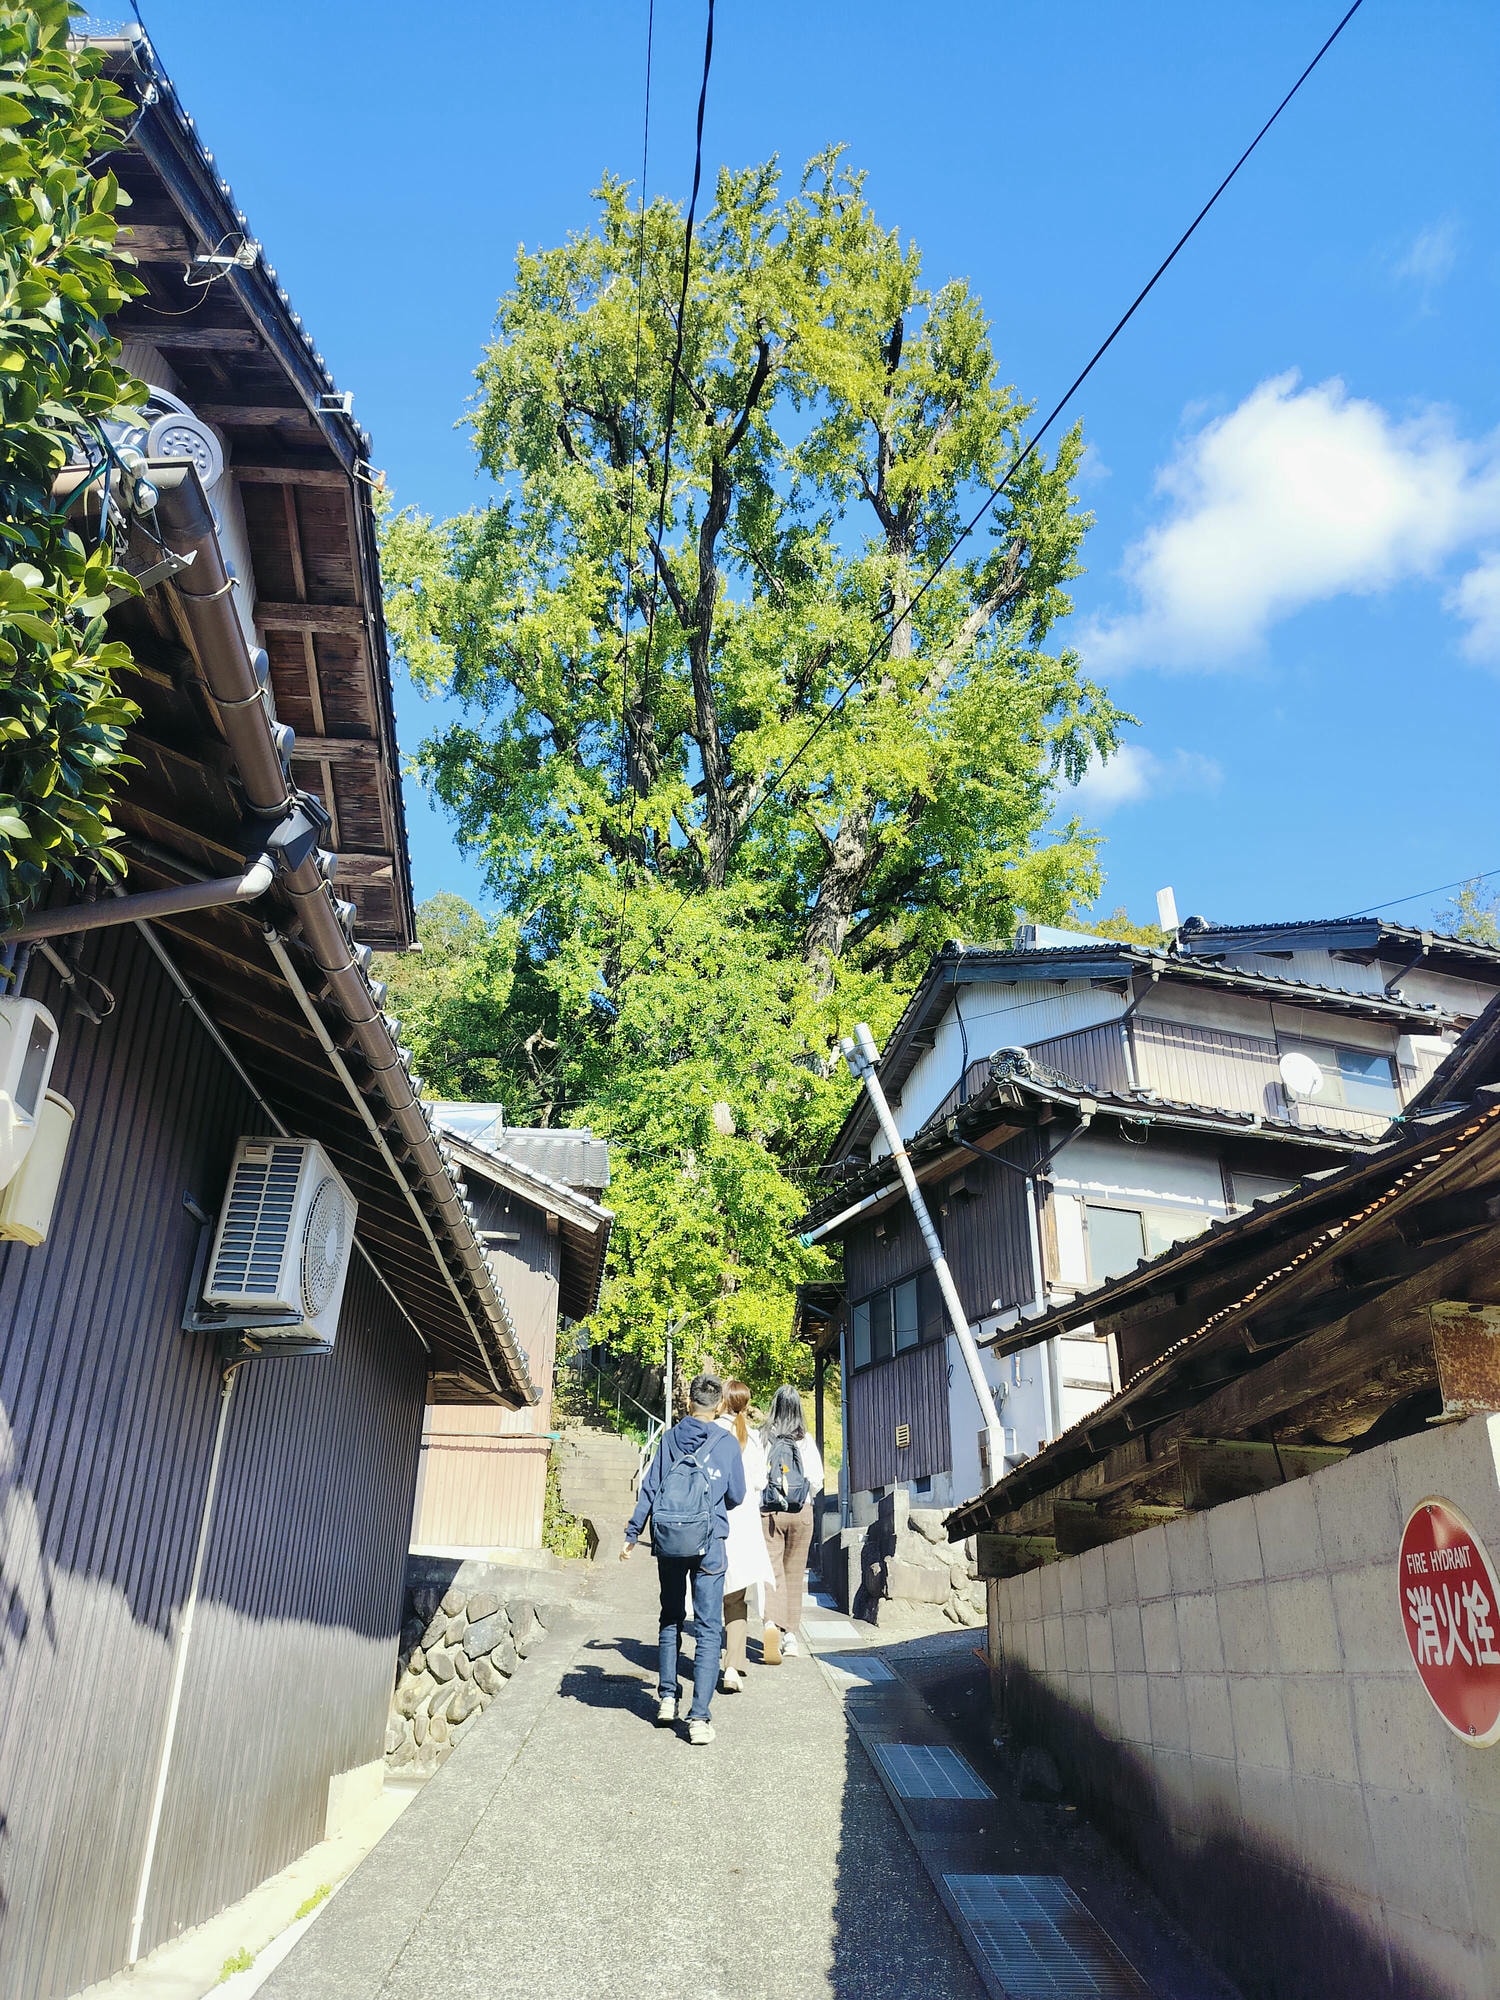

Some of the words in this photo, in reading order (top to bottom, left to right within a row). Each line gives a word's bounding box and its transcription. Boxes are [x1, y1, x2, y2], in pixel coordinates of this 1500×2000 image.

[1406, 1552, 1429, 1575] FIRE
[1429, 1545, 1472, 1572] HYDRANT
[1406, 1580, 1500, 1667] 消火栓
